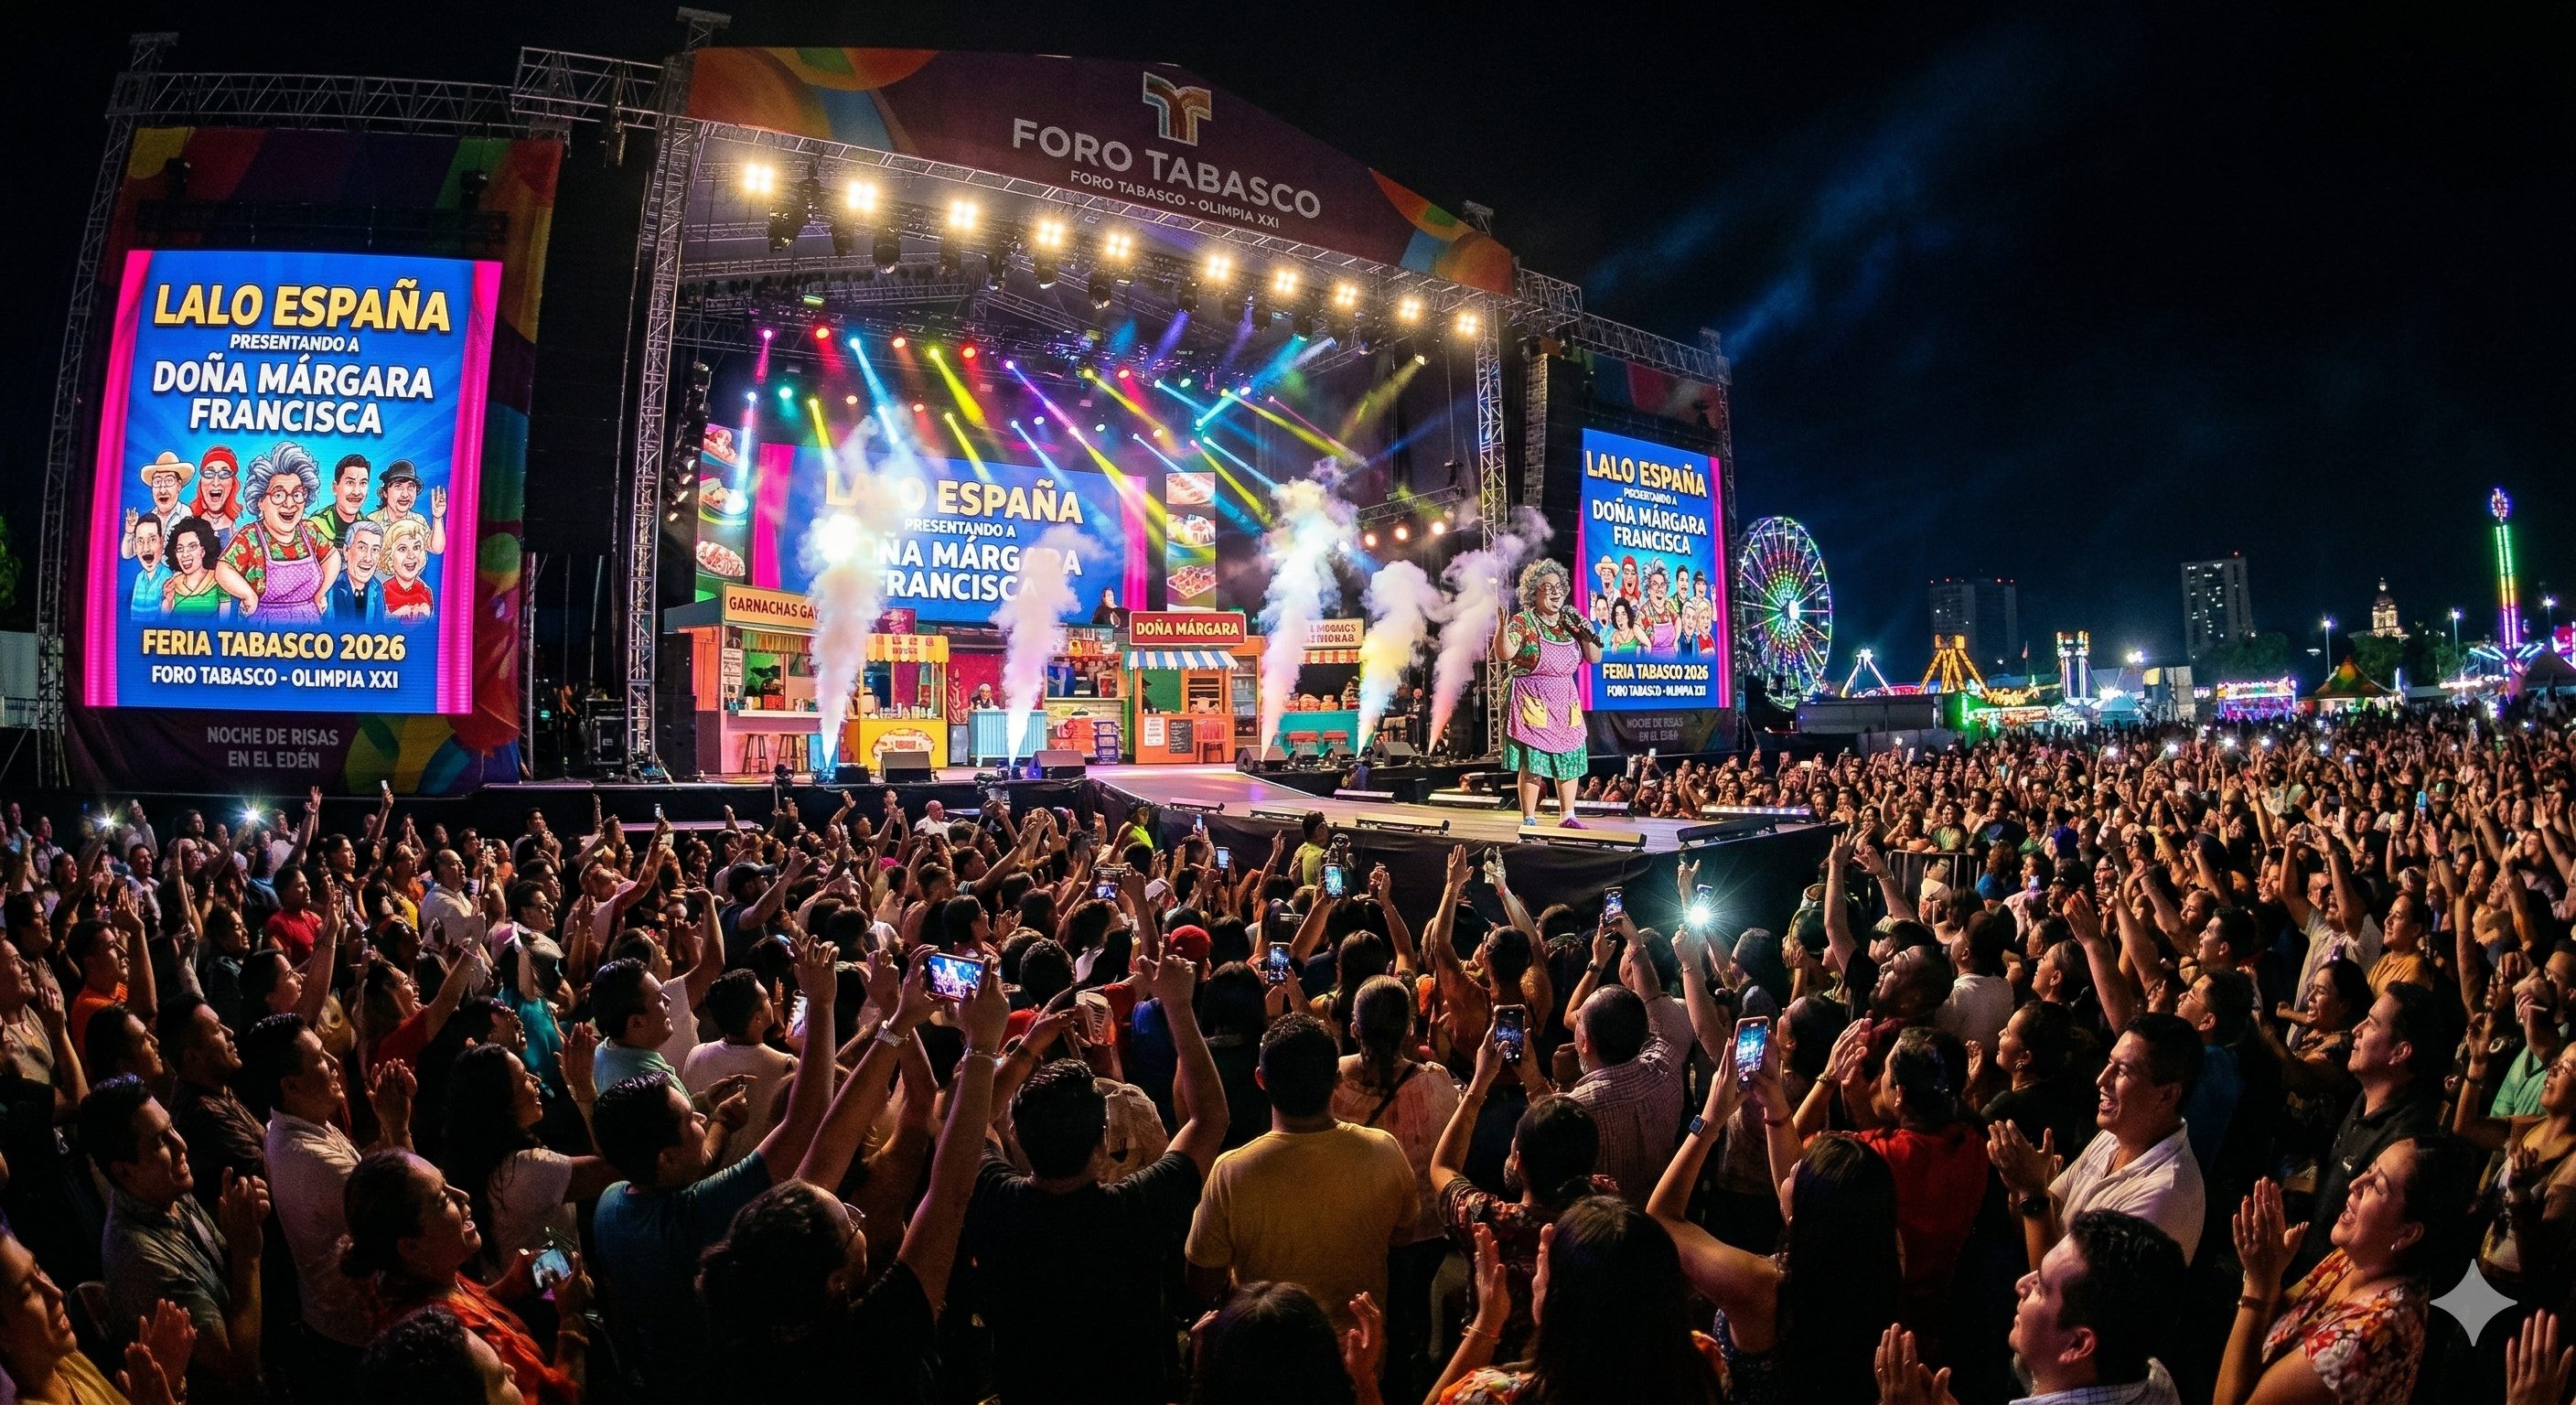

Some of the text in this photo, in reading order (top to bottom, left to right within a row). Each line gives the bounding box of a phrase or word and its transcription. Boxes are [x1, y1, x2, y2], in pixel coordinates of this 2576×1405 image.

[1013, 117, 1321, 219] FORO TABASCO
[1070, 169, 1113, 190] FORO
[1118, 180, 1186, 207] TABASCO
[1198, 199, 1254, 223] OLIMPIA
[1258, 212, 1279, 229] XXI
[154, 278, 451, 332] LALO ESPAÑA
[230, 334, 360, 353] PRESENTANDO A
[153, 352, 434, 400] DOÑA MÁRGARA
[189, 398, 383, 435] FRANCISCA
[1585, 450, 1708, 498] LALO ESPAÑA
[937, 478, 1084, 524] ESPAÑA
[1671, 495, 1678, 506] A
[904, 519, 1016, 538] PRESENTANDO A
[1592, 498, 1708, 536] DOÑA MÁRGARA
[1613, 525, 1691, 555] FRANCISCA
[729, 596, 798, 617] GARNACHAS
[1135, 617, 1240, 636] DOÑA MÁRGARA
[143, 629, 406, 661] FERIA TABASCO 2026
[152, 665, 197, 684] FORO
[199, 667, 277, 686] TABASCO
[292, 669, 366, 688] OLIMPIA
[368, 670, 399, 689] XXI
[1602, 663, 1710, 681] FERIA TABASCO 2026
[207, 726, 339, 746] NOCHE DE RISAS
[228, 747, 319, 769] EN EL EDÉN
